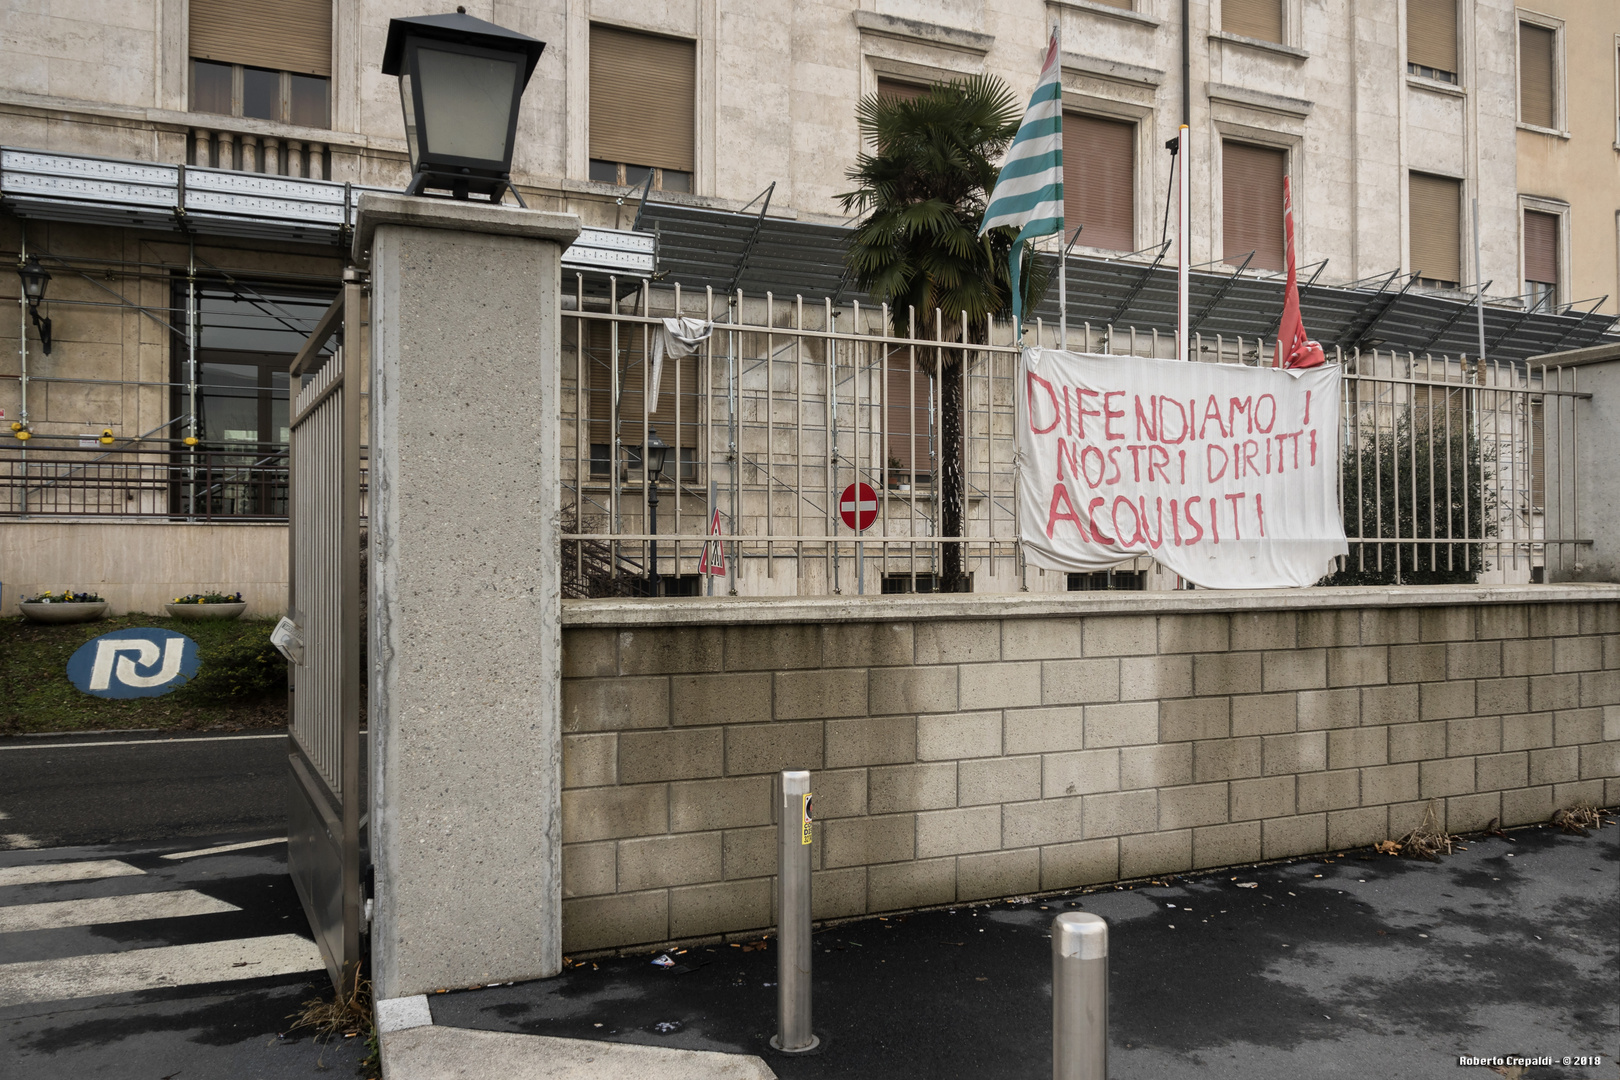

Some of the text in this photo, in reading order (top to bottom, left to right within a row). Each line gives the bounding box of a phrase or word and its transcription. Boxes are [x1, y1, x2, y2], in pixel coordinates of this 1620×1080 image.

[1026, 370, 1277, 443] DIFENDIAMO
[1056, 428, 1318, 490] NOSTRI DIRITTI
[1045, 482, 1265, 550] ACQUISITI
